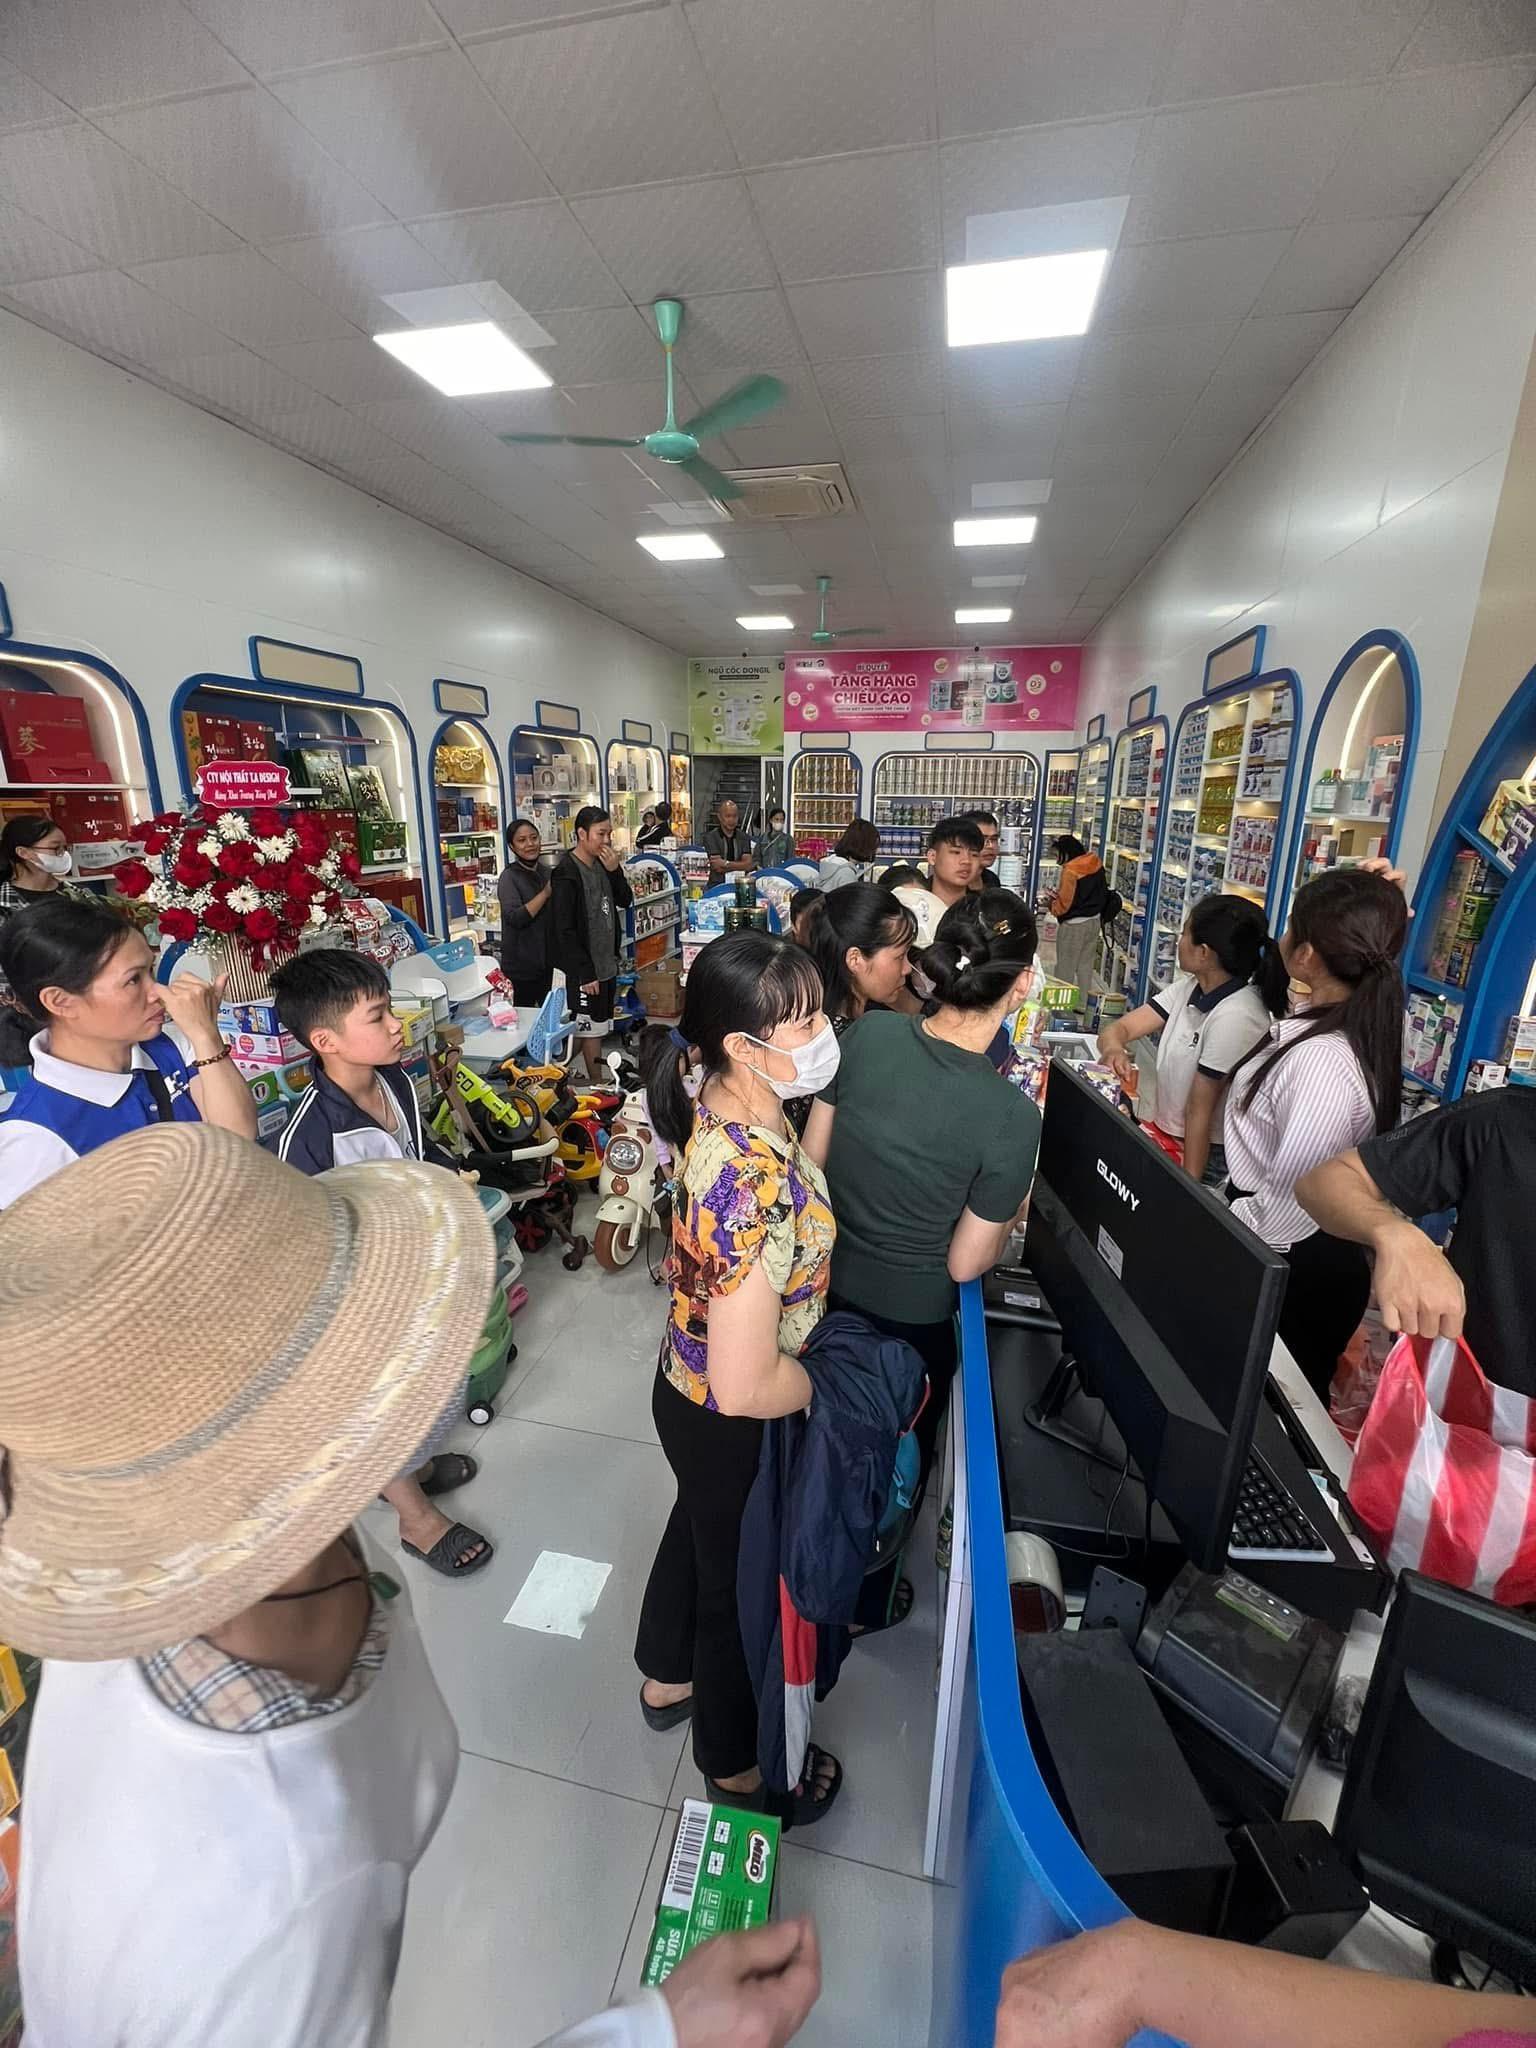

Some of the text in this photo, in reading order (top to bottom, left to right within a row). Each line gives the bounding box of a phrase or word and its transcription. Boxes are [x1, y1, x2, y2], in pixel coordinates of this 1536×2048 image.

[831, 672, 916, 690] TĂNG HẠNG
[880, 692, 911, 704] CAO
[1096, 1158, 1140, 1211] GLOWY
[750, 1837, 765, 1877] MILO
